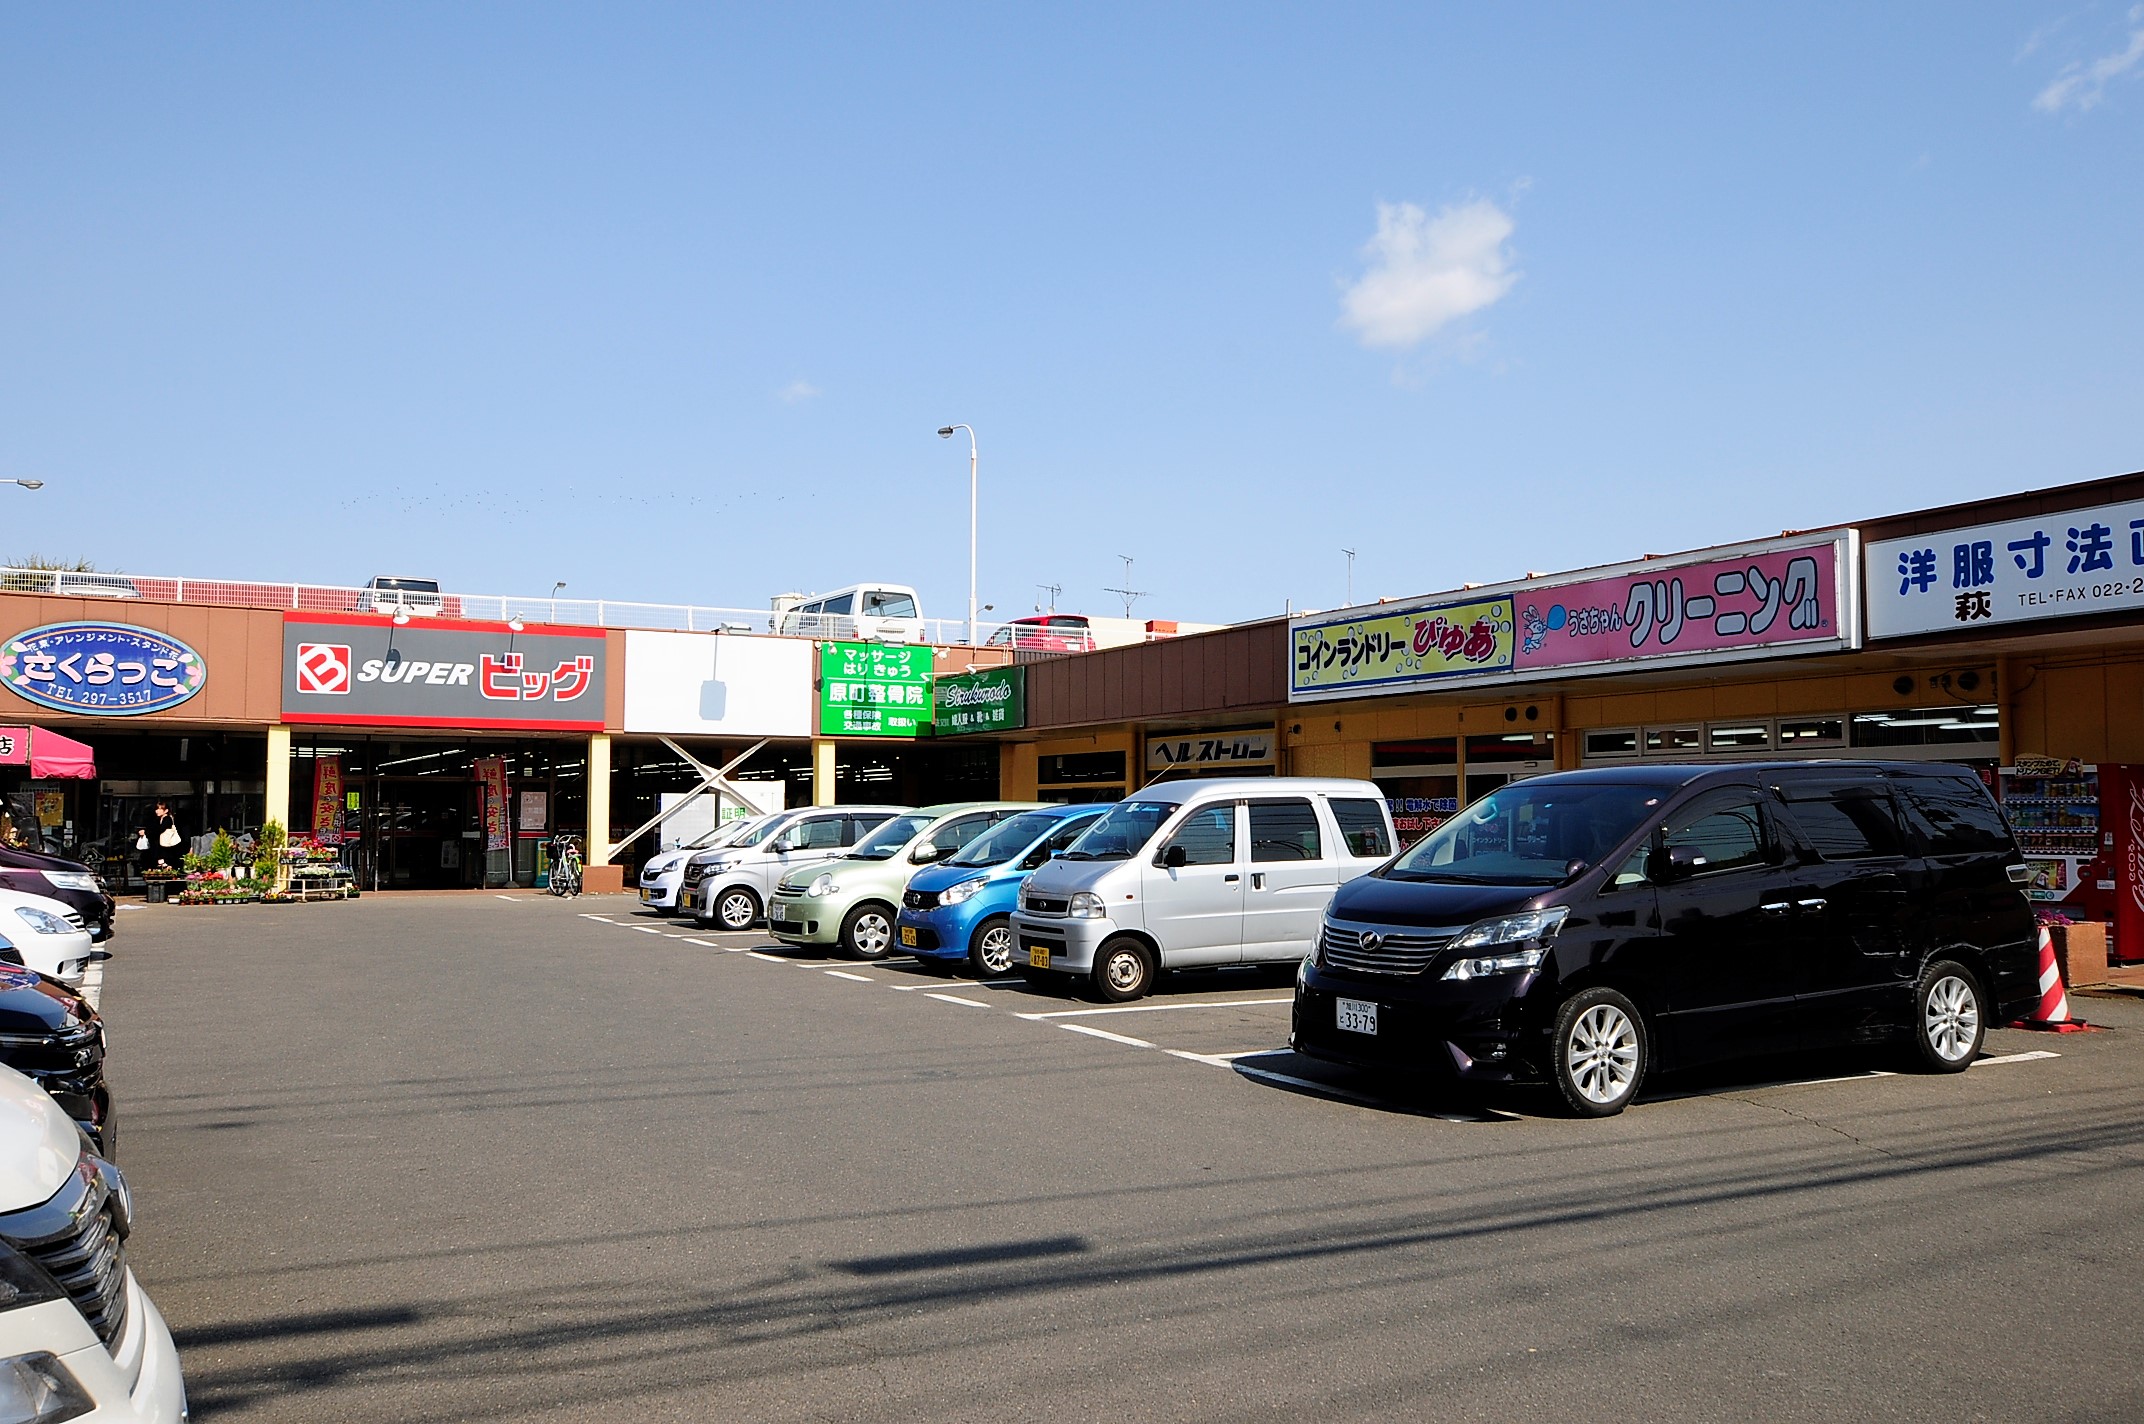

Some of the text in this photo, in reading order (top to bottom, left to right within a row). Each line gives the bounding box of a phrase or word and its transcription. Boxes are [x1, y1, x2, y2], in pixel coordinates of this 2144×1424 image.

[1568, 555, 1820, 648] うさちゃん クリーニング
[1954, 590, 1992, 622] 萩
[843, 649, 912, 664] マッサージ
[1298, 631, 1406, 671] コインランドリー
[23, 650, 179, 687] さくらっこ
[357, 658, 475, 686] SUPER
[479, 652, 594, 702] ビッグ
[843, 662, 912, 677] はり きゅう
[47, 683, 151, 706] TEL 297-3517
[829, 682, 924, 704] 原町整骨院
[843, 720, 882, 731] 交通事故
[721, 807, 746, 820] 証明
[1345, 1011, 1376, 1032] 33-79
